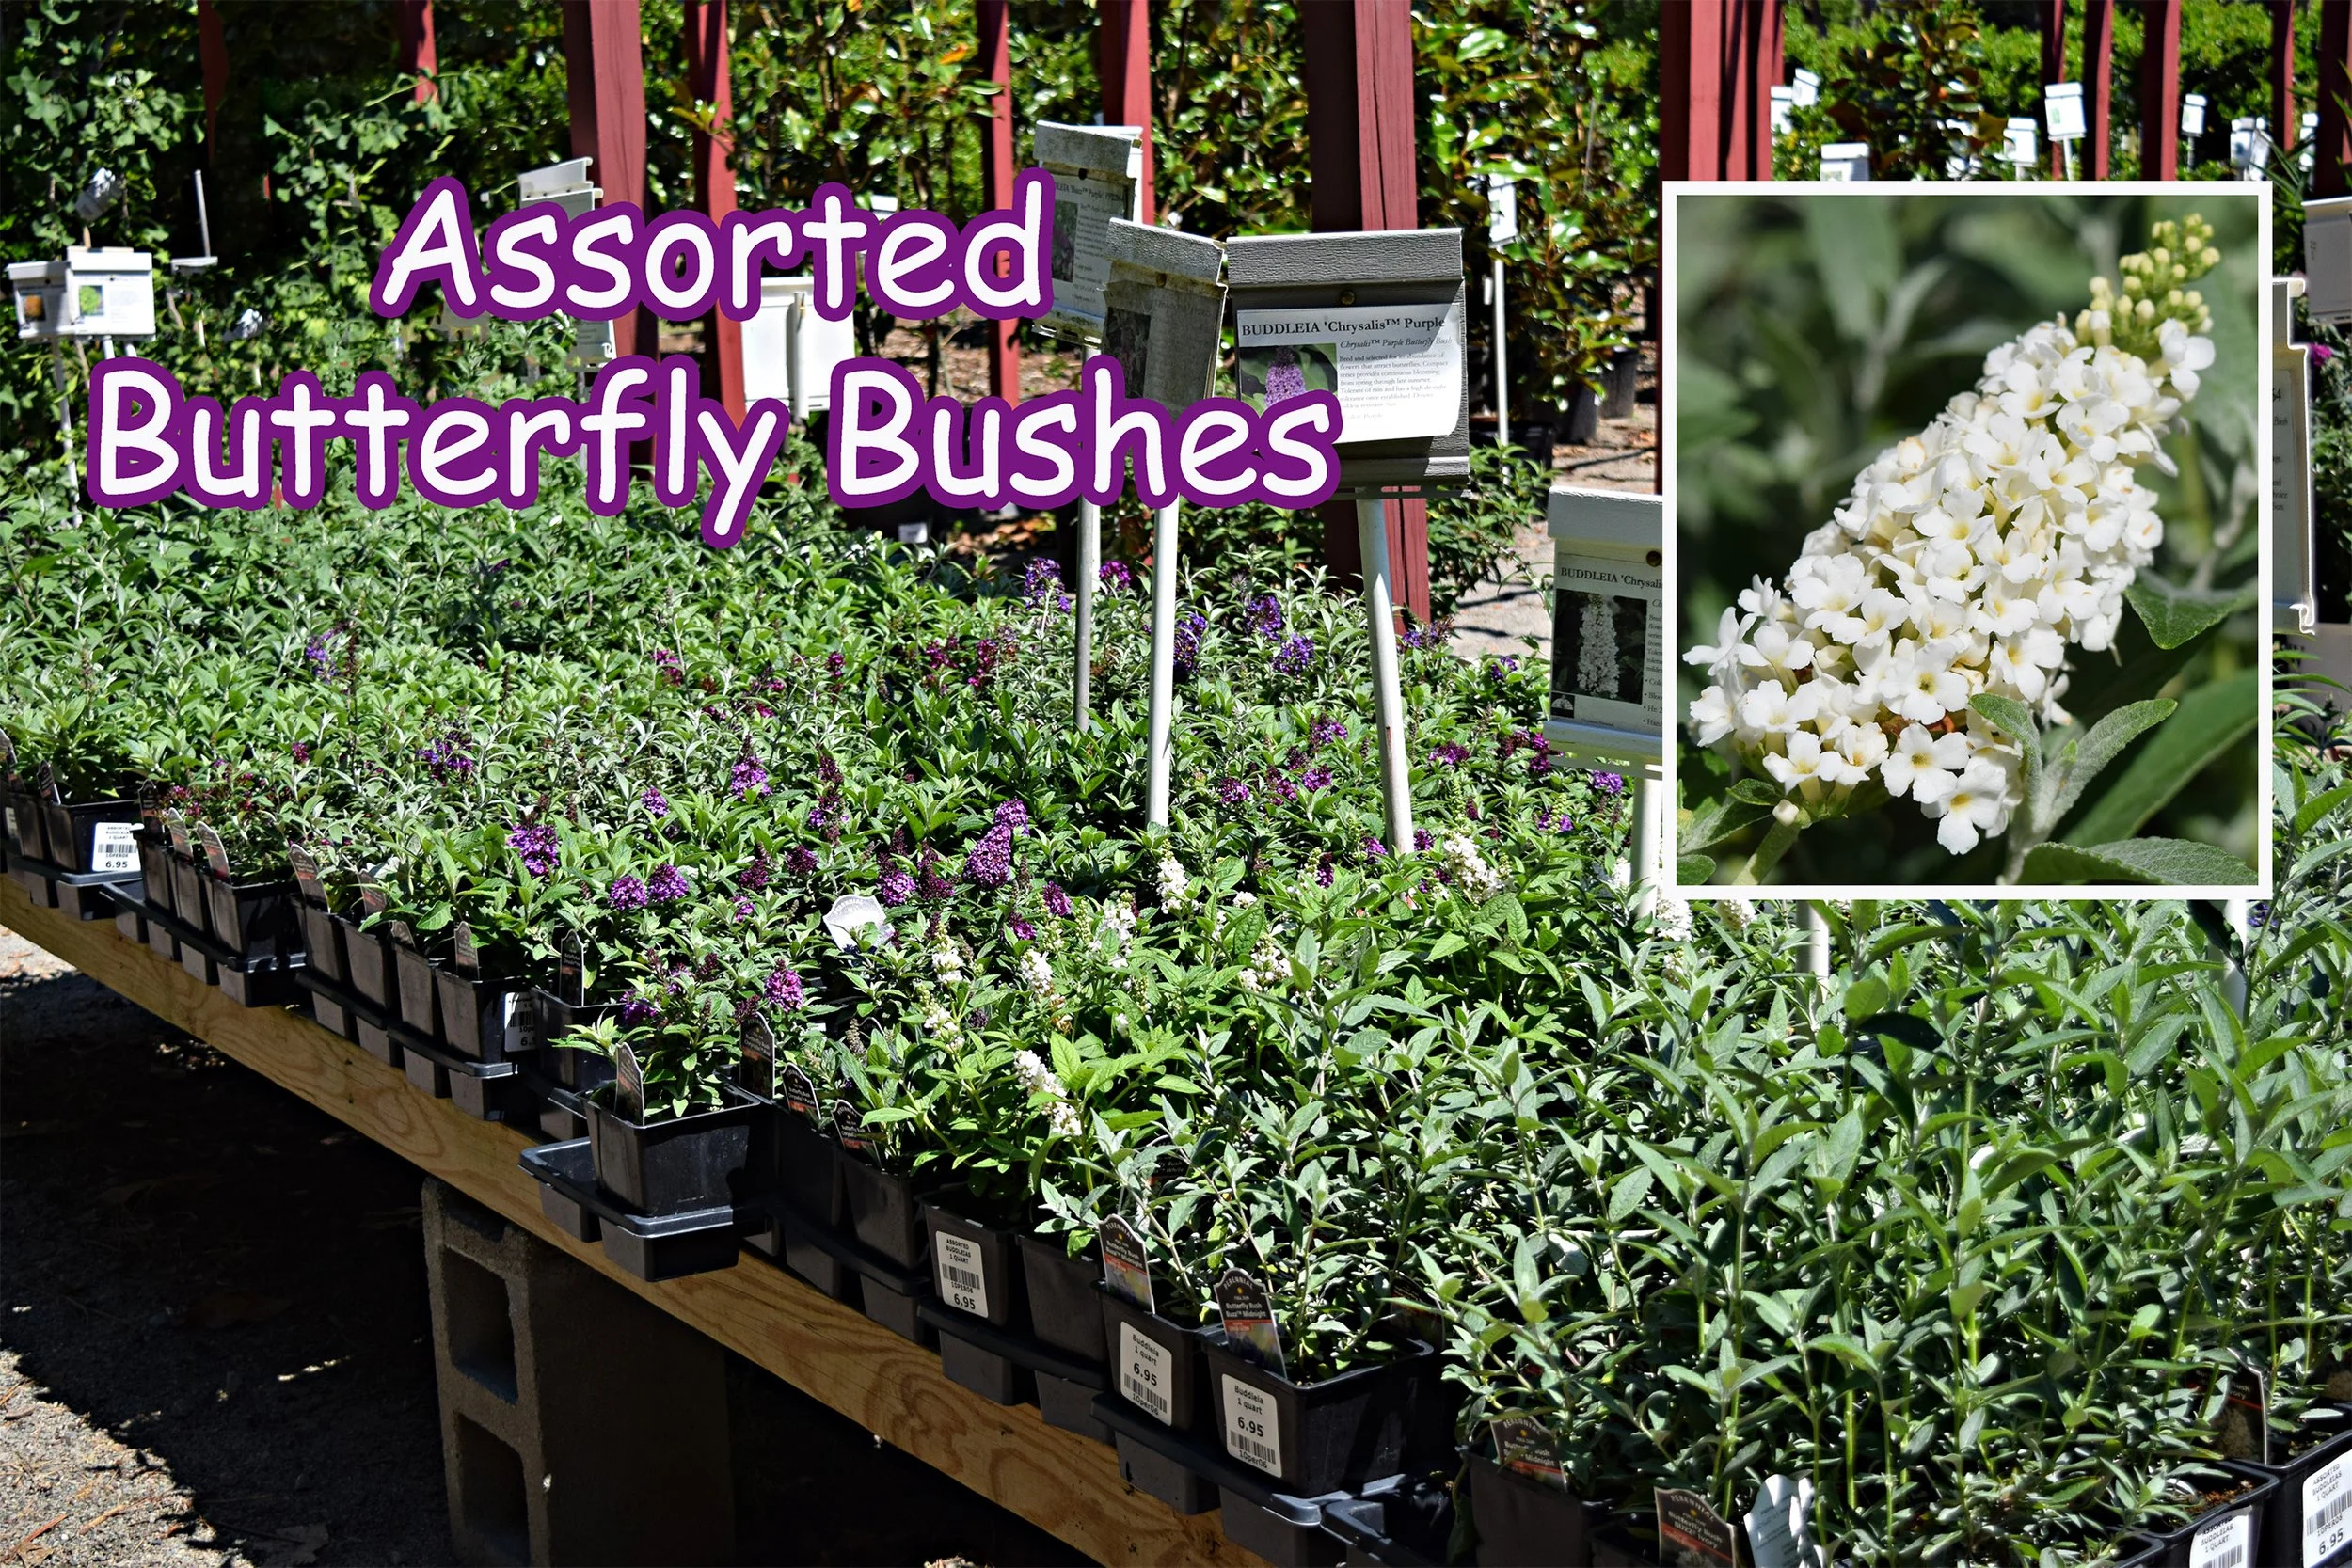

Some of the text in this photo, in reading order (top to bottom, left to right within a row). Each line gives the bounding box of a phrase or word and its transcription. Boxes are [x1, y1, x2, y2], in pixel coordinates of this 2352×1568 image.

[1241, 321, 1320, 336] BUDDLEIA
[1405, 316, 1446, 331] Purple
[1382, 338, 1404, 349] Purple
[1406, 337, 1433, 347] Butterfly
[1435, 336, 1453, 344] Bush
[1357, 370, 1379, 379] provides
[1374, 377, 1396, 386] through
[1561, 566, 1662, 589] BUDDLEIA 'Chrysali
[105, 860, 128, 868] 6.95
[1106, 1240, 1141, 1260] Butterfly Bush
[954, 1293, 976, 1310] 6.95
[1225, 1302, 1248, 1310] Butterfly
[1242, 1310, 1267, 1319] Midnight
[1132, 1334, 1159, 1357] Buddleia
[1140, 1349, 1157, 1366] quart
[1133, 1362, 1158, 1386] 6.95
[1234, 1385, 1264, 1405] Buddleia
[1243, 1401, 1263, 1415] quart
[1237, 1416, 1263, 1438] 6.95
[1238, 1449, 1268, 1469] 10per06
[2312, 1463, 2341, 1485] ASSORTED
[2321, 1481, 2339, 1499] QUART
[1667, 1511, 1702, 1533] Butterfly
[1703, 1528, 1723, 1544] Bush
[1697, 1533, 1718, 1549] Ivory
[2210, 1534, 2229, 1551] QUART
[2318, 1528, 2344, 1555] 6.95
